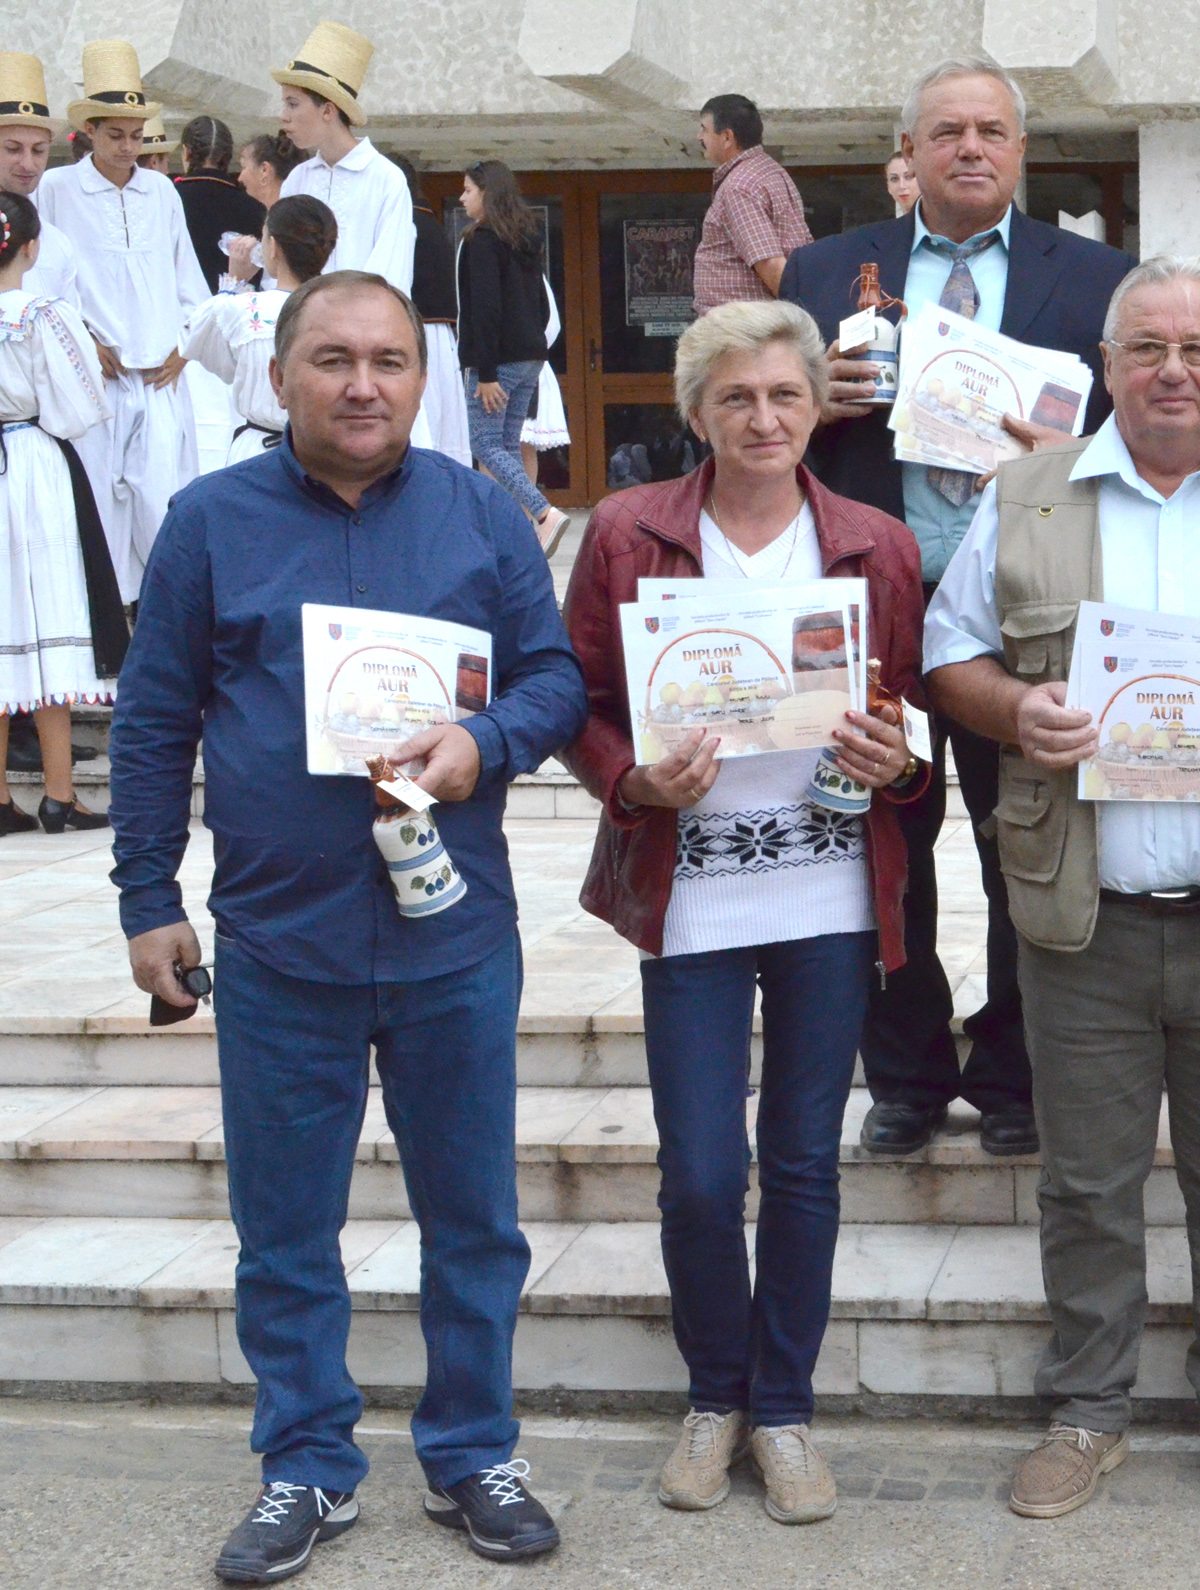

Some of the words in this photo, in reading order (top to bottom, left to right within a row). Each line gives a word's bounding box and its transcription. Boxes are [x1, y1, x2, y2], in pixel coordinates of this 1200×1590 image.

[961, 377, 988, 397] AUR
[698, 660, 733, 677] AUR
[377, 678, 409, 693] AUR
[1149, 706, 1184, 721] AUR
